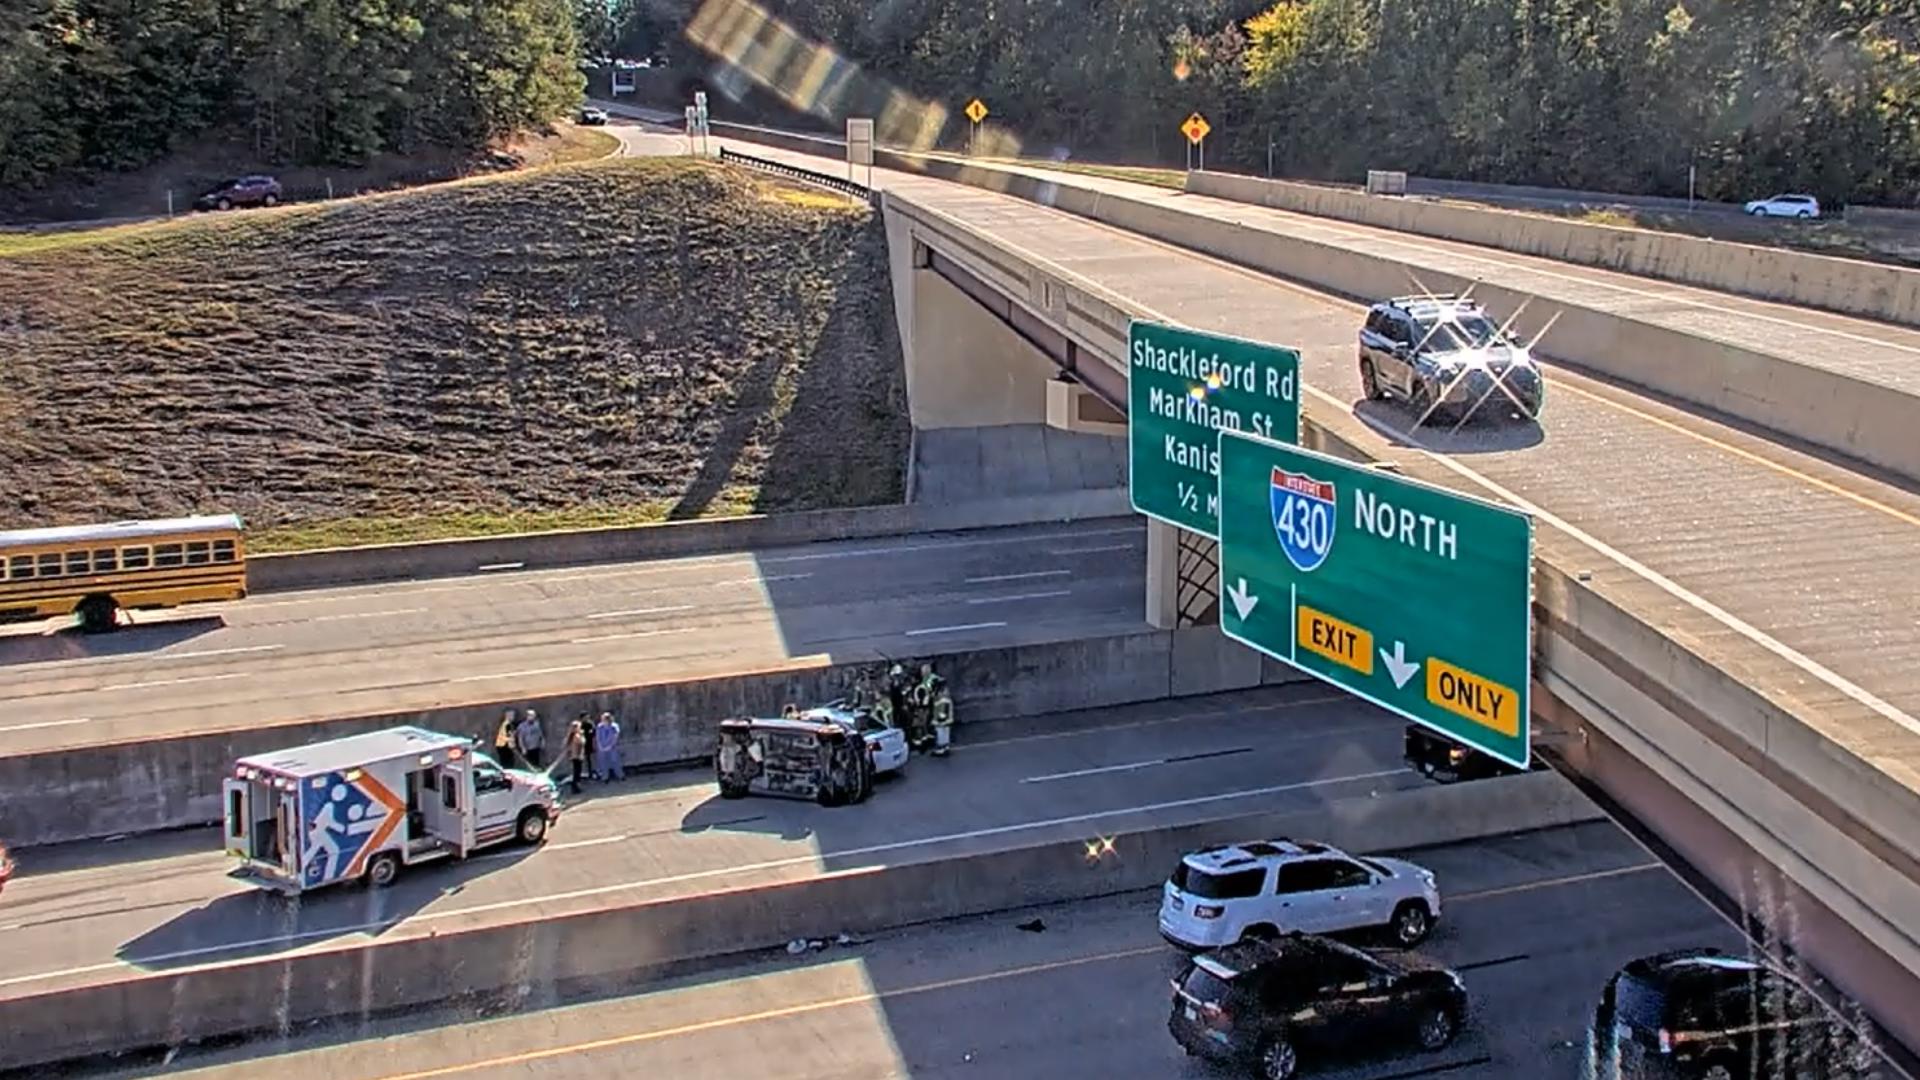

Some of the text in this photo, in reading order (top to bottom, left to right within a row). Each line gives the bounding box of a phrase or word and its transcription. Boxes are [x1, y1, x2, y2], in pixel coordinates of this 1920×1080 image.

[1133, 338, 1294, 401] Shackleford Rd
[1150, 386, 1273, 438] Markham St
[1165, 434, 1219, 476] Kanis
[1276, 495, 1329, 556] 430
[1355, 488, 1457, 560] NORTH
[1312, 618, 1504, 720] EXIT ONLY
